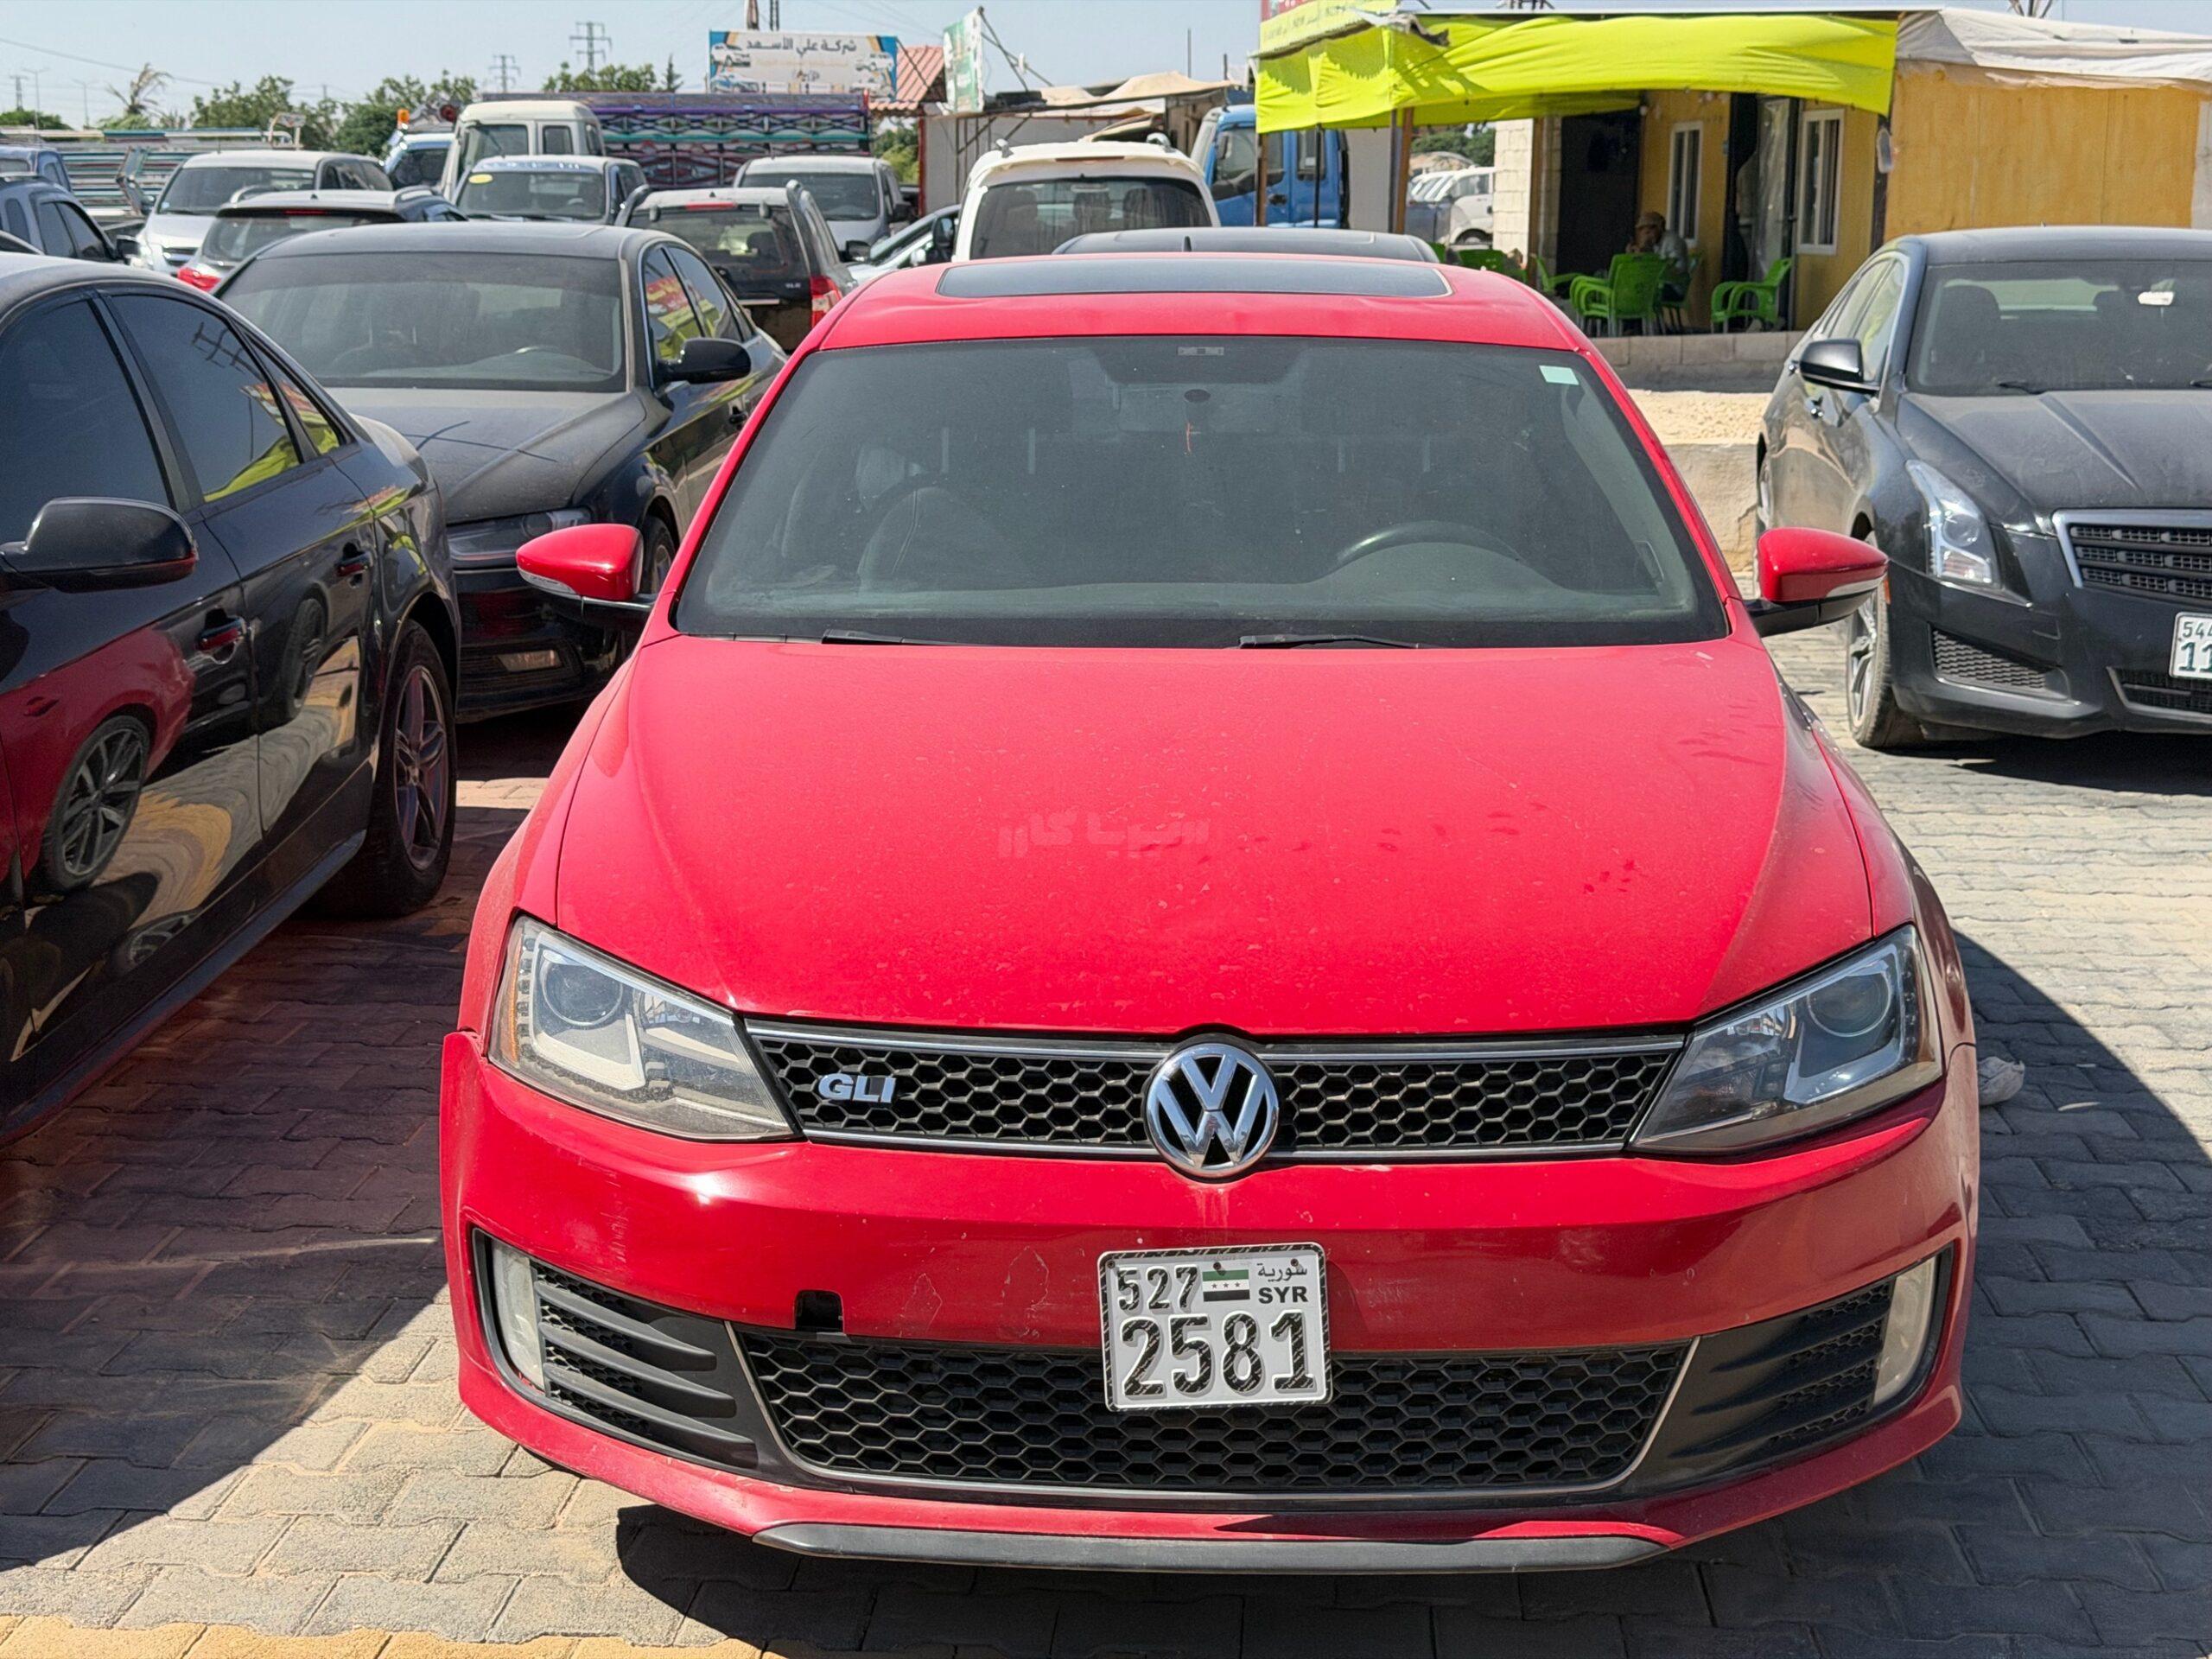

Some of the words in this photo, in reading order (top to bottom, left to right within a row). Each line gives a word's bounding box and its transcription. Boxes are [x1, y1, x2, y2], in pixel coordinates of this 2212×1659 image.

[796, 38, 819, 58] علي
[820, 39, 857, 55] شركة
[817, 1072, 897, 1103] GLI
[1257, 1262, 1307, 1283] سورية
[1116, 1265, 1198, 1312] 527
[1258, 1286, 1309, 1305] SYR
[1121, 1311, 1315, 1398] 2581
